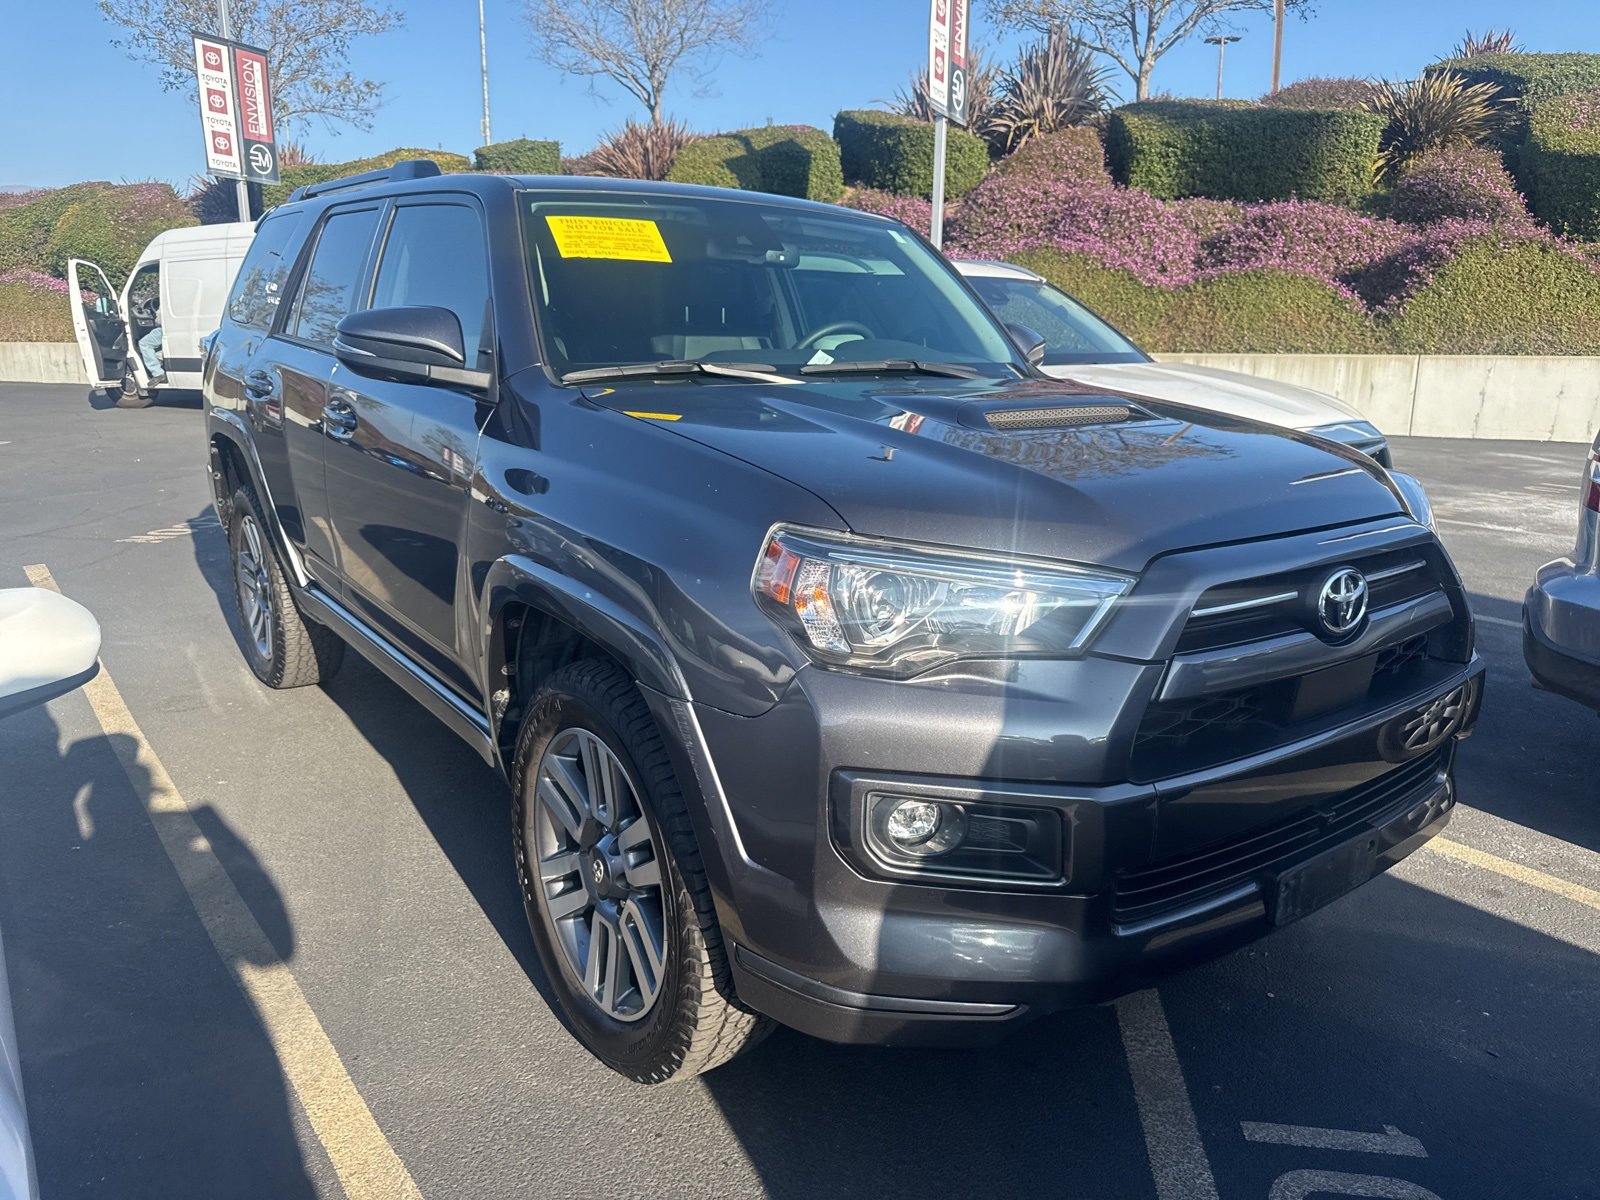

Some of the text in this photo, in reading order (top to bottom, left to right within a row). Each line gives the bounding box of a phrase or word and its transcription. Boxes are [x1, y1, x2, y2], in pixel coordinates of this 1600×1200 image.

[201, 73, 228, 85] TOYOTA
[242, 58, 260, 134] ENVISION
[206, 116, 232, 127] TOYOTA
[212, 158, 238, 169] TOYOTA
[586, 219, 632, 227] VEHICLE
